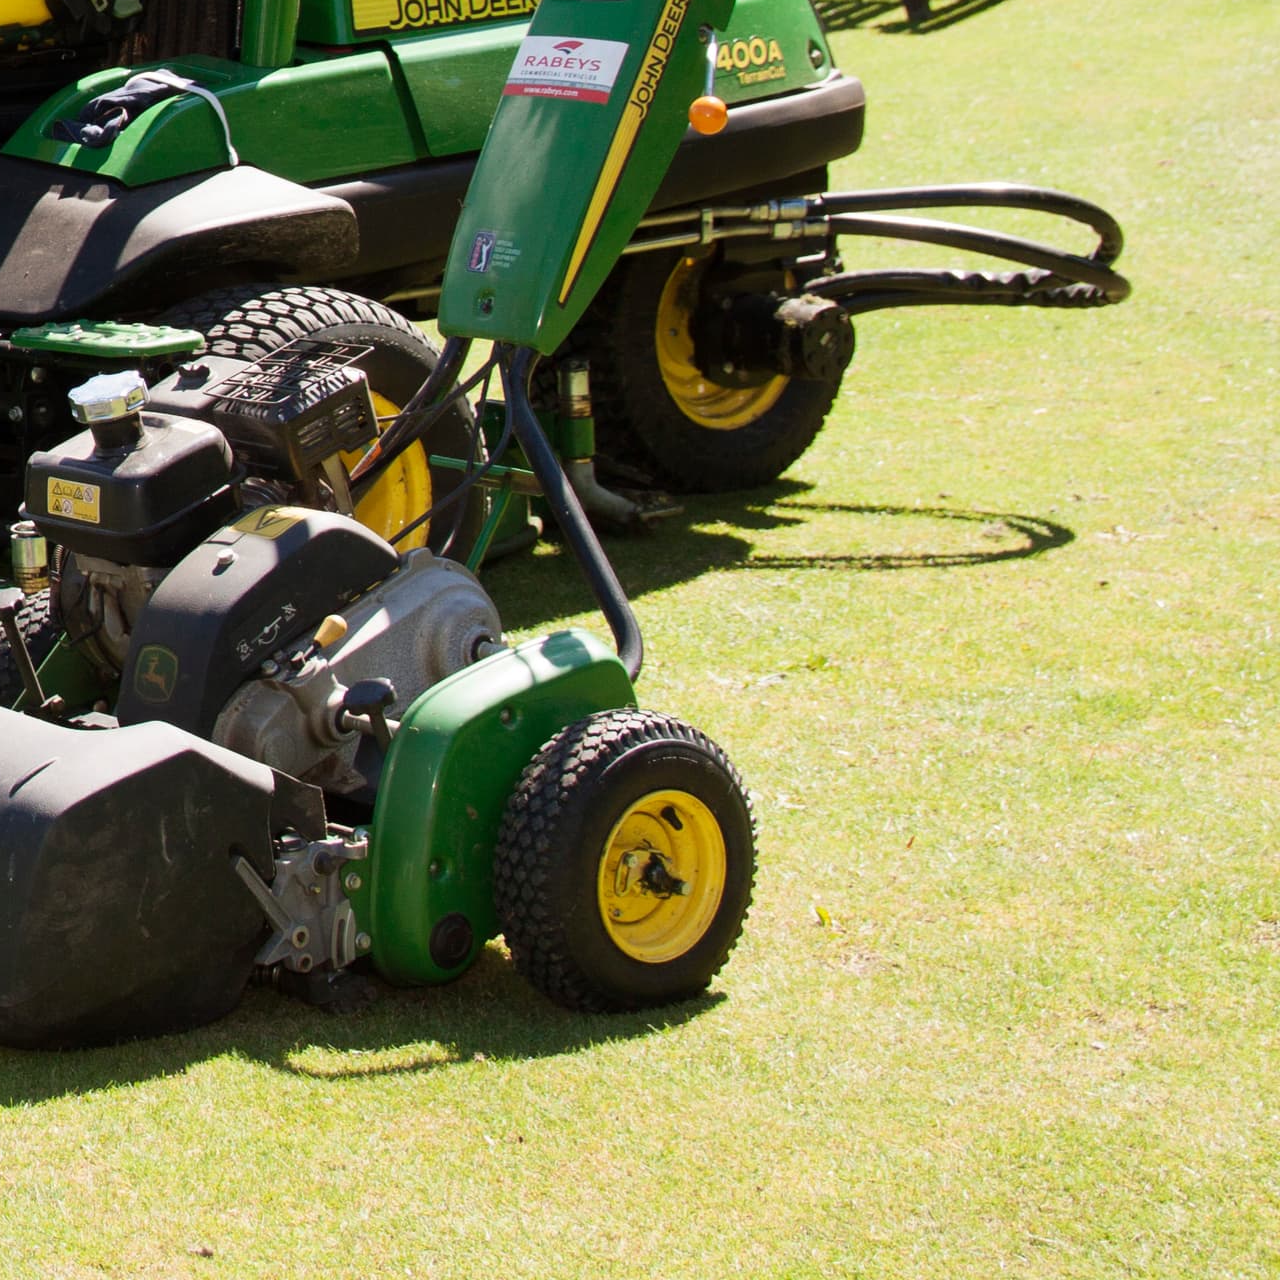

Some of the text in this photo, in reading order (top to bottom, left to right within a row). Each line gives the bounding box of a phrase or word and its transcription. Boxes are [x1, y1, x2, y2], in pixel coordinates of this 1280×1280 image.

[524, 55, 602, 72] RABEYS
[524, 86, 579, 97] www.rabeys.com
[630, 54, 665, 118] JOHN
